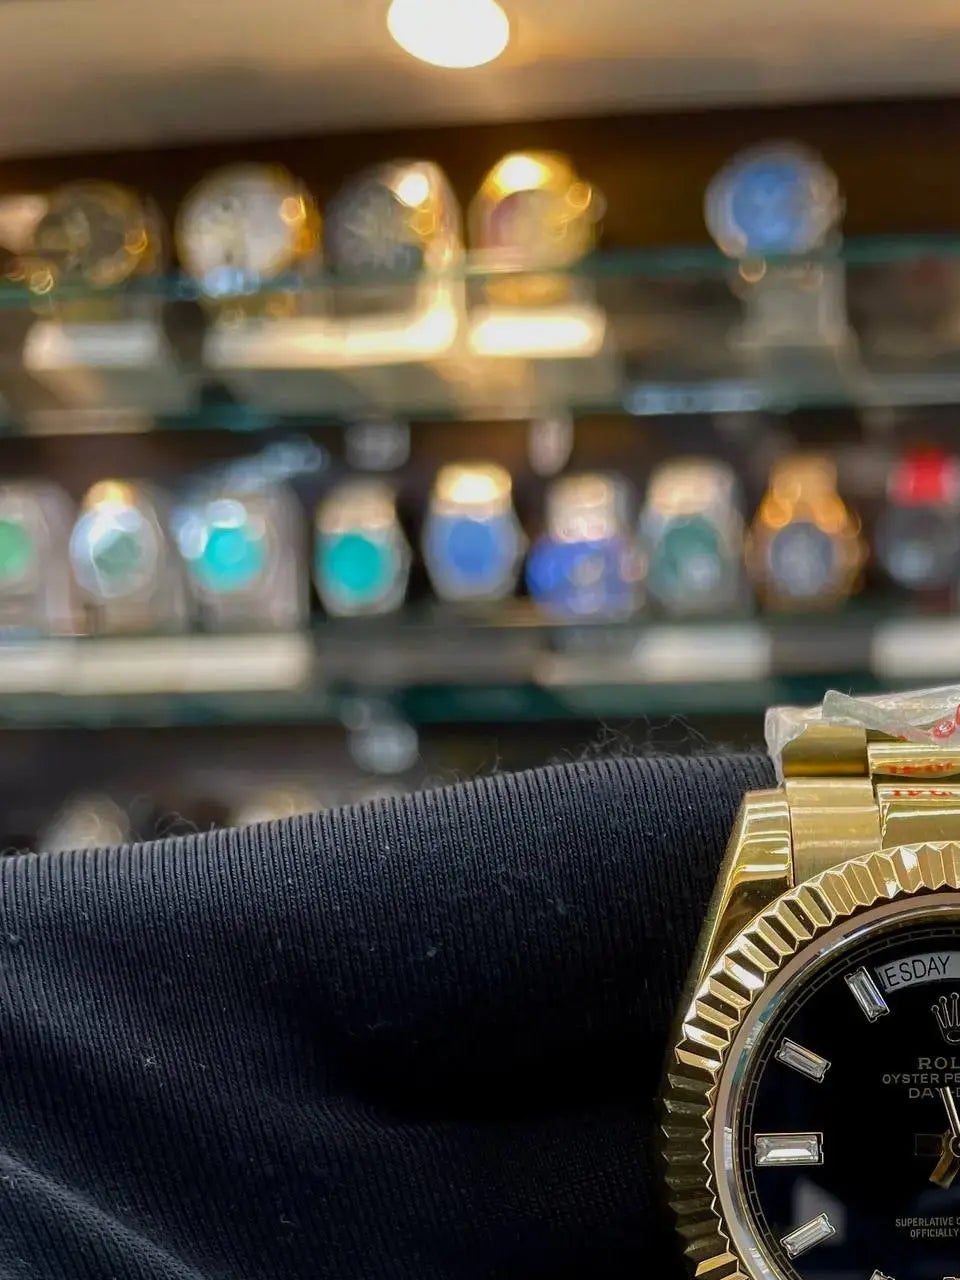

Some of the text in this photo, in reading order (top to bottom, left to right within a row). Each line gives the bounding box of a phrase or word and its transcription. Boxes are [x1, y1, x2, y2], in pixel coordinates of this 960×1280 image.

[878, 955, 950, 989] ESDAY
[882, 1073, 940, 1084] OYSTER
[895, 1217, 954, 1227] SUPERLATIVE
[910, 1228, 959, 1238] OFFICIALLY
